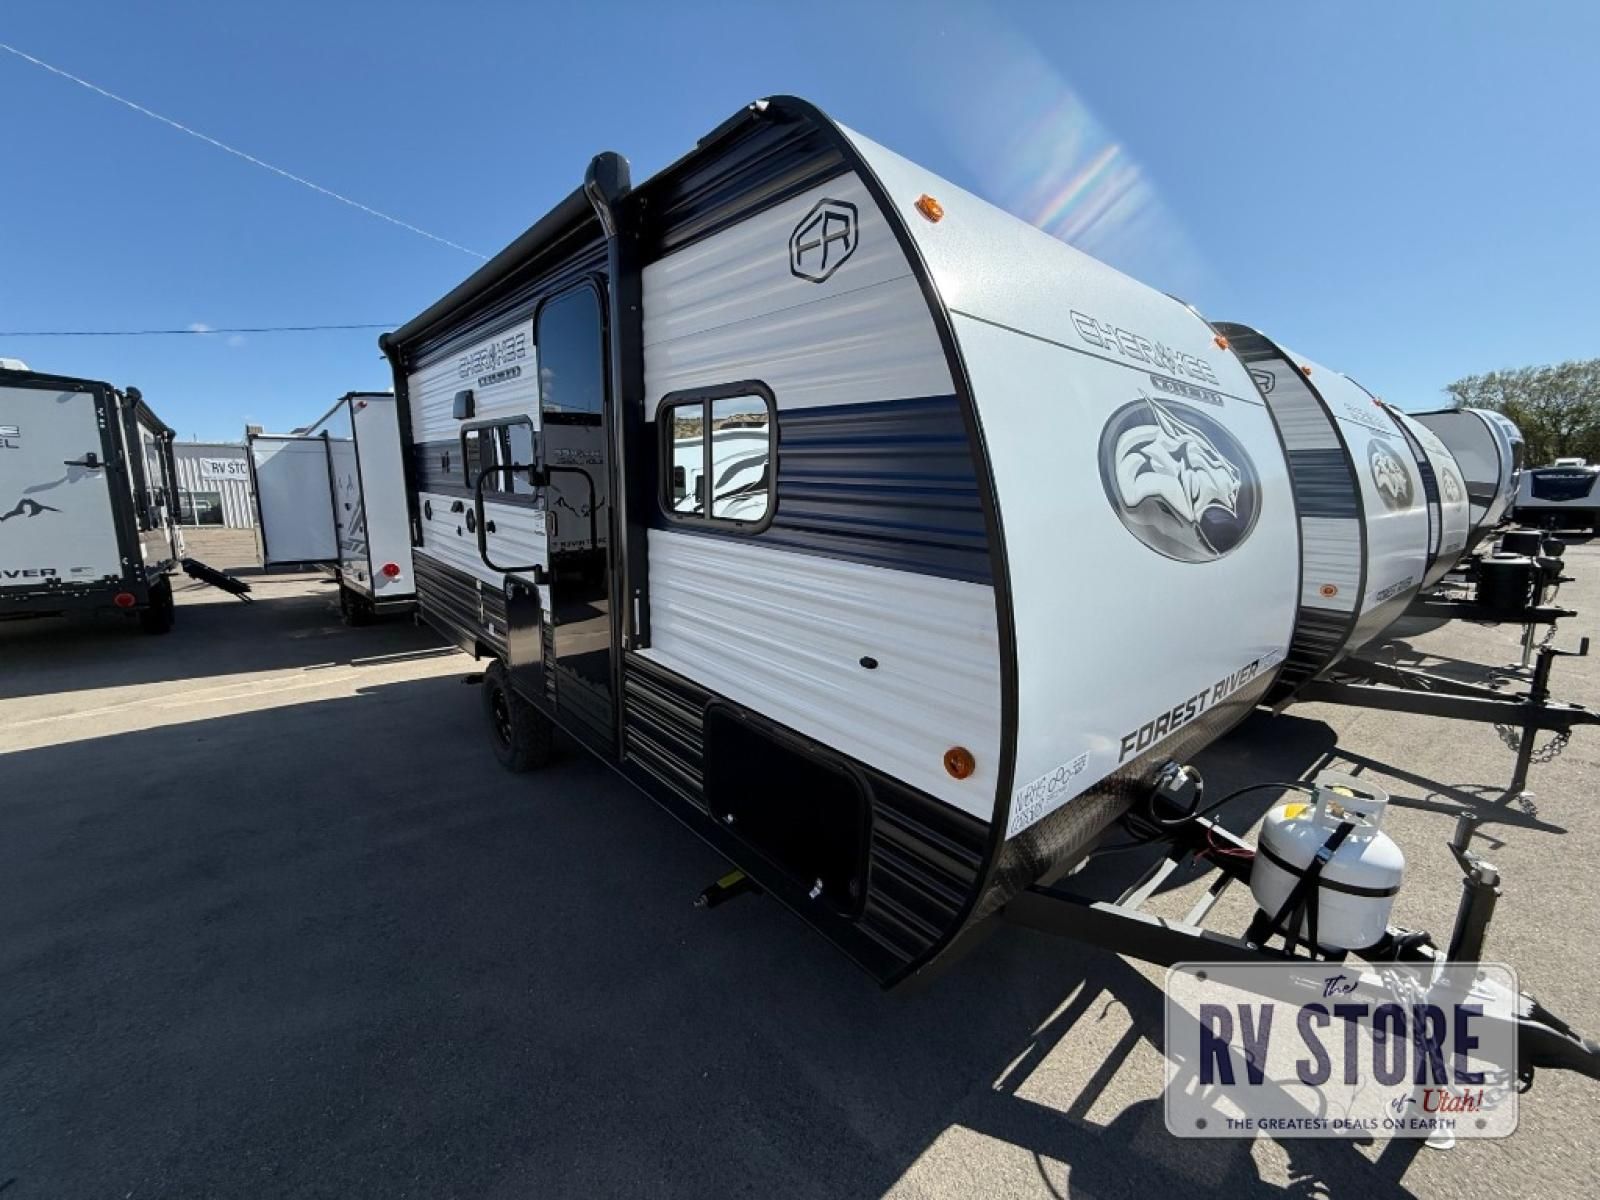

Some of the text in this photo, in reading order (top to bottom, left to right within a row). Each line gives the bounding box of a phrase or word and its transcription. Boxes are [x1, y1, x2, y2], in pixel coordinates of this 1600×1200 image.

[211, 462, 226, 473] RV
[1118, 658, 1260, 763] FOREST RIVER
